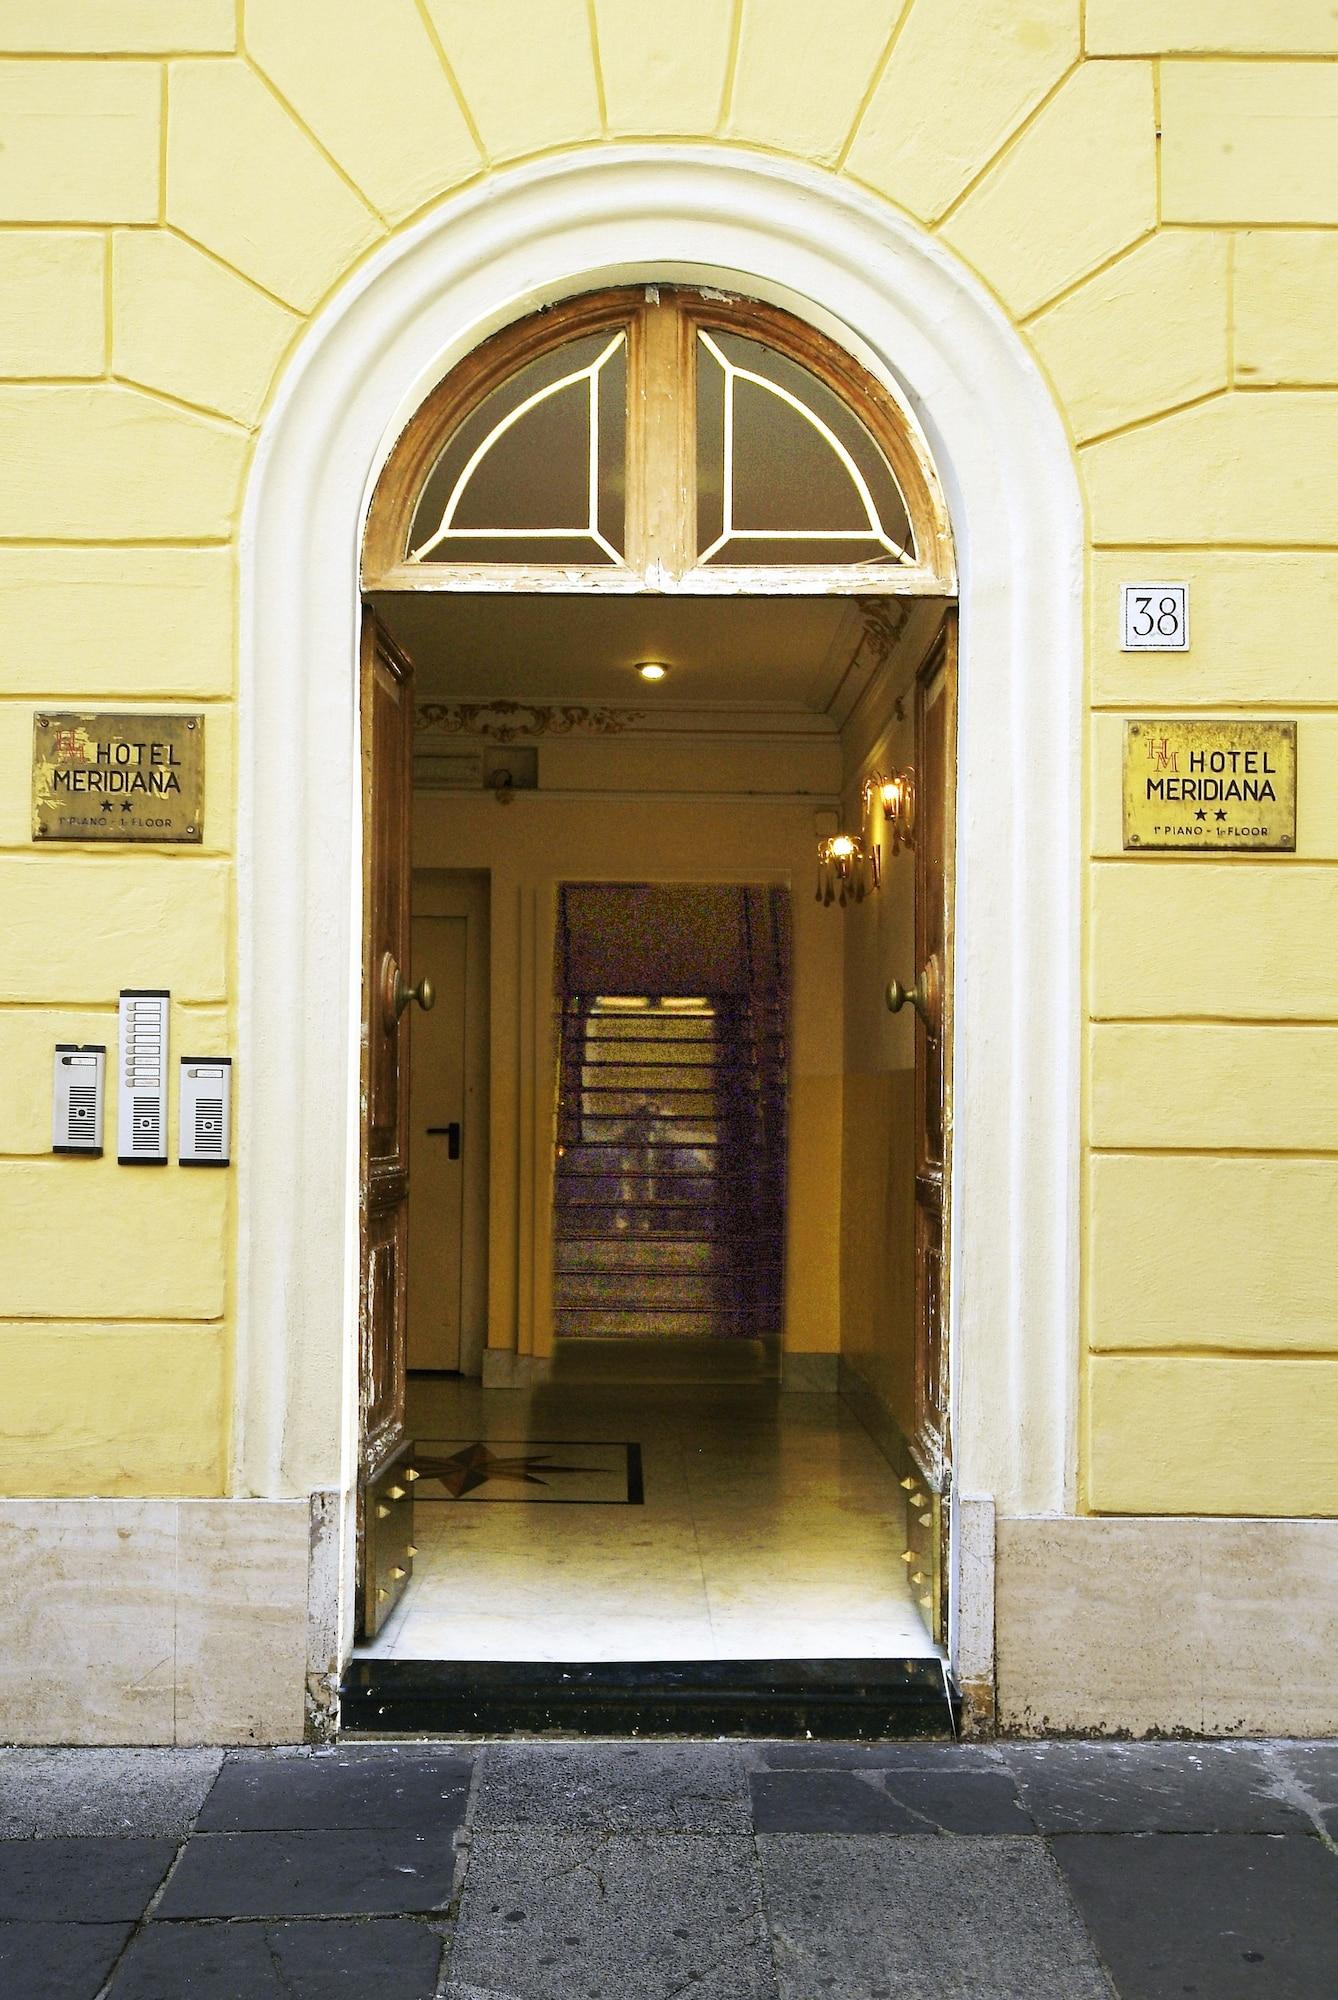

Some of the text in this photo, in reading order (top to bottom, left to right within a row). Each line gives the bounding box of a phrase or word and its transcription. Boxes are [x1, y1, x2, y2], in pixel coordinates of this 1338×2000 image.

[1133, 597, 1178, 636] 38
[97, 743, 181, 766] HOTEL
[1190, 751, 1276, 774] HOTEL
[53, 770, 181, 793] MERIDIANA
[1146, 778, 1276, 801] MERIDIANA
[69, 817, 107, 826] PIANO
[132, 818, 172, 827] FLOOR
[1164, 826, 1203, 836] PIANO
[1228, 826, 1268, 836] FLOOR
